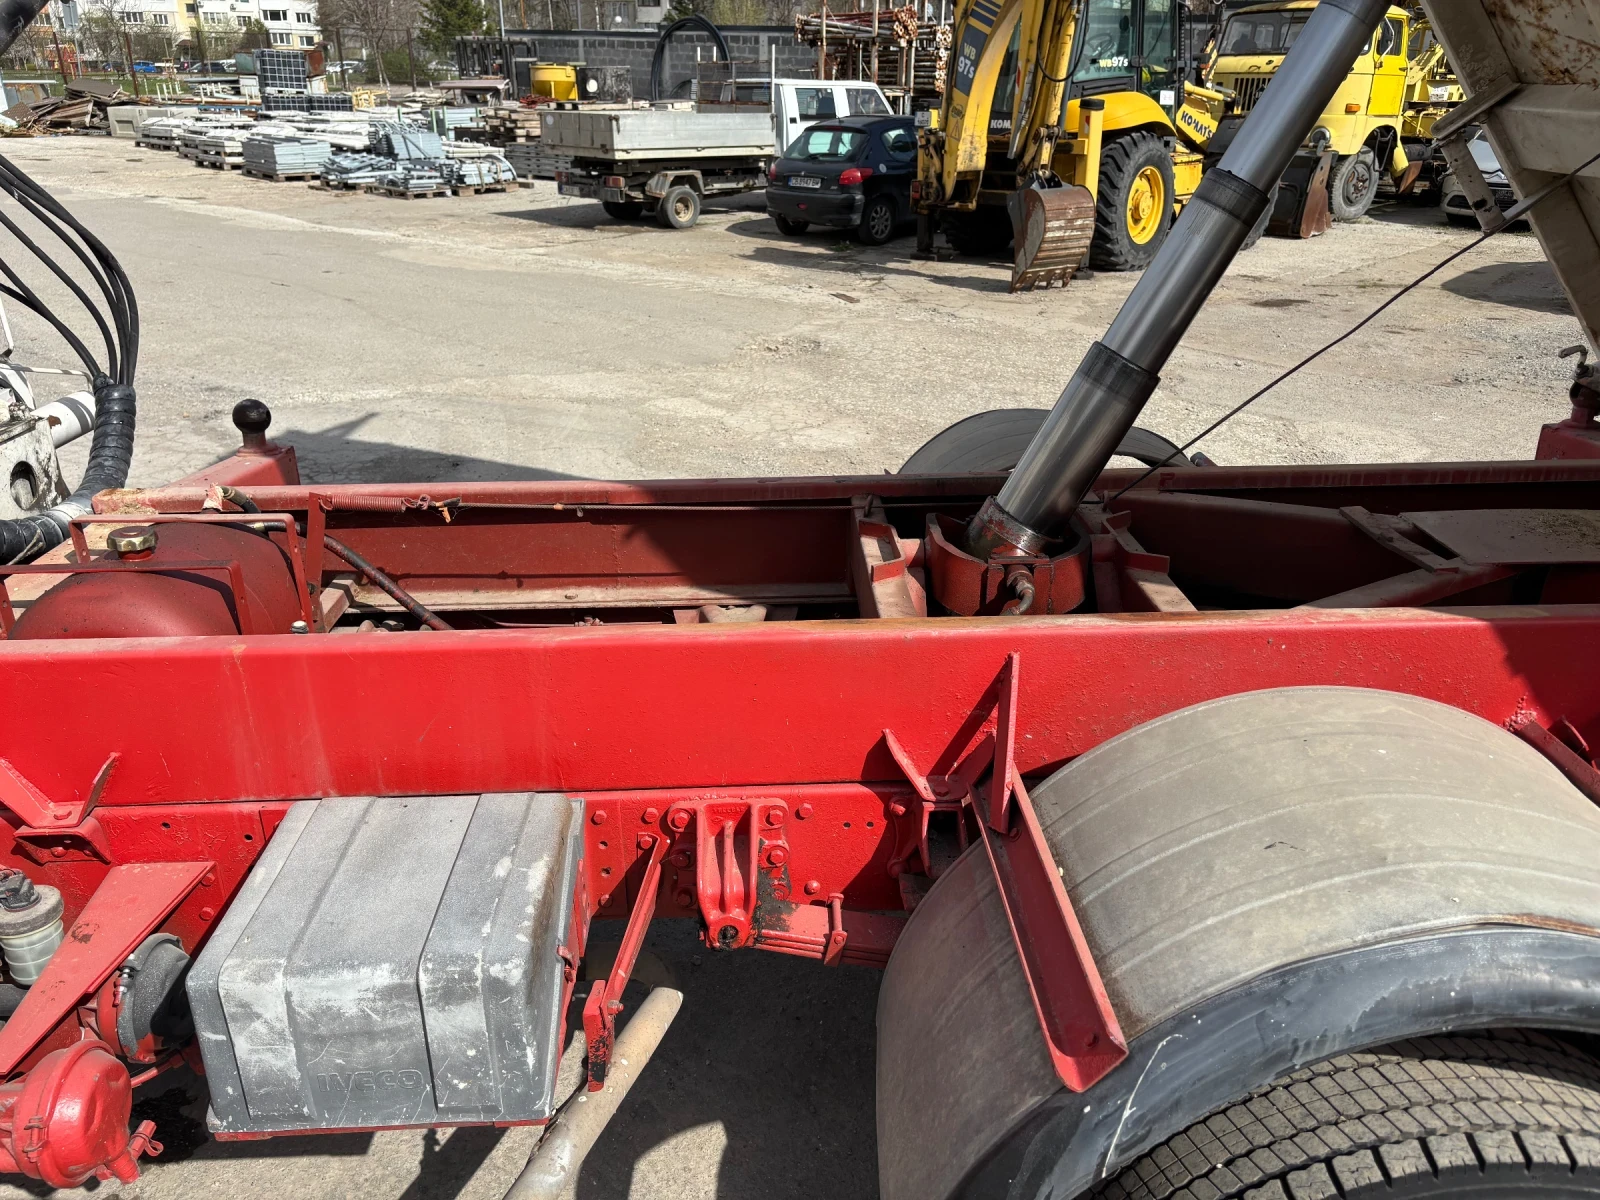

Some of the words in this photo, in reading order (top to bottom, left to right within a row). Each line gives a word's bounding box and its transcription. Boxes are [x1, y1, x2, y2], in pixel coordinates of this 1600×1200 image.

[964, 43, 976, 60] WB
[958, 56, 975, 79] 97s
[990, 119, 1011, 129] KOM
[1181, 111, 1213, 140] KOMATS
[317, 1069, 423, 1092] IVECO
